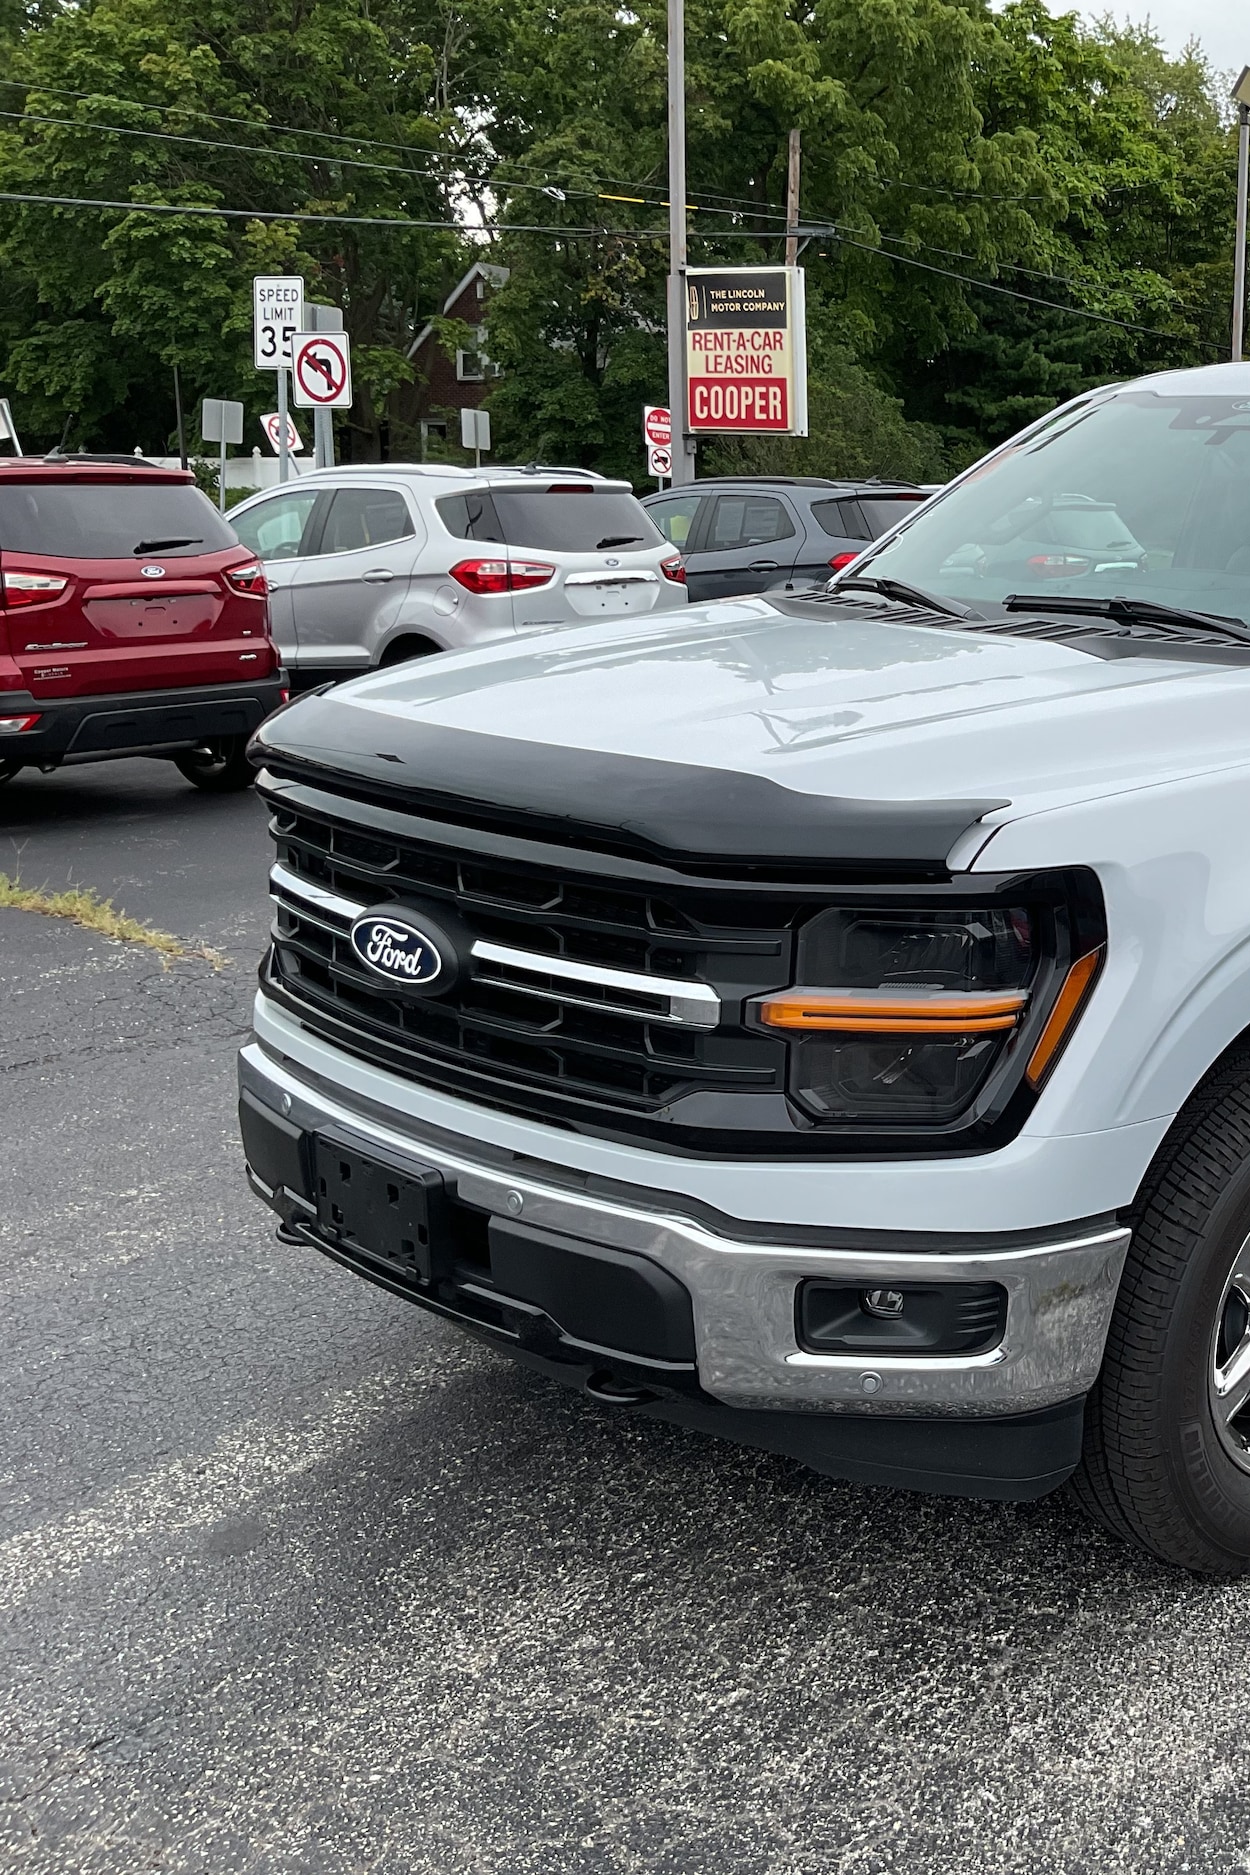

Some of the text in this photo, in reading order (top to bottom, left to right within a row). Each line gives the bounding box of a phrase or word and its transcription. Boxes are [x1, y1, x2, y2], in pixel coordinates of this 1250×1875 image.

[259, 289, 299, 302] SPEED
[710, 289, 765, 299] THE LINCOLN
[263, 308, 294, 321] LIMIT
[711, 302, 785, 312] MOTOR COMPANY
[261, 326, 296, 358] 35
[692, 331, 783, 351] RENT-A-CAR
[705, 355, 772, 374] LEASING
[695, 386, 782, 420] COOPER
[367, 924, 422, 975] Ford
